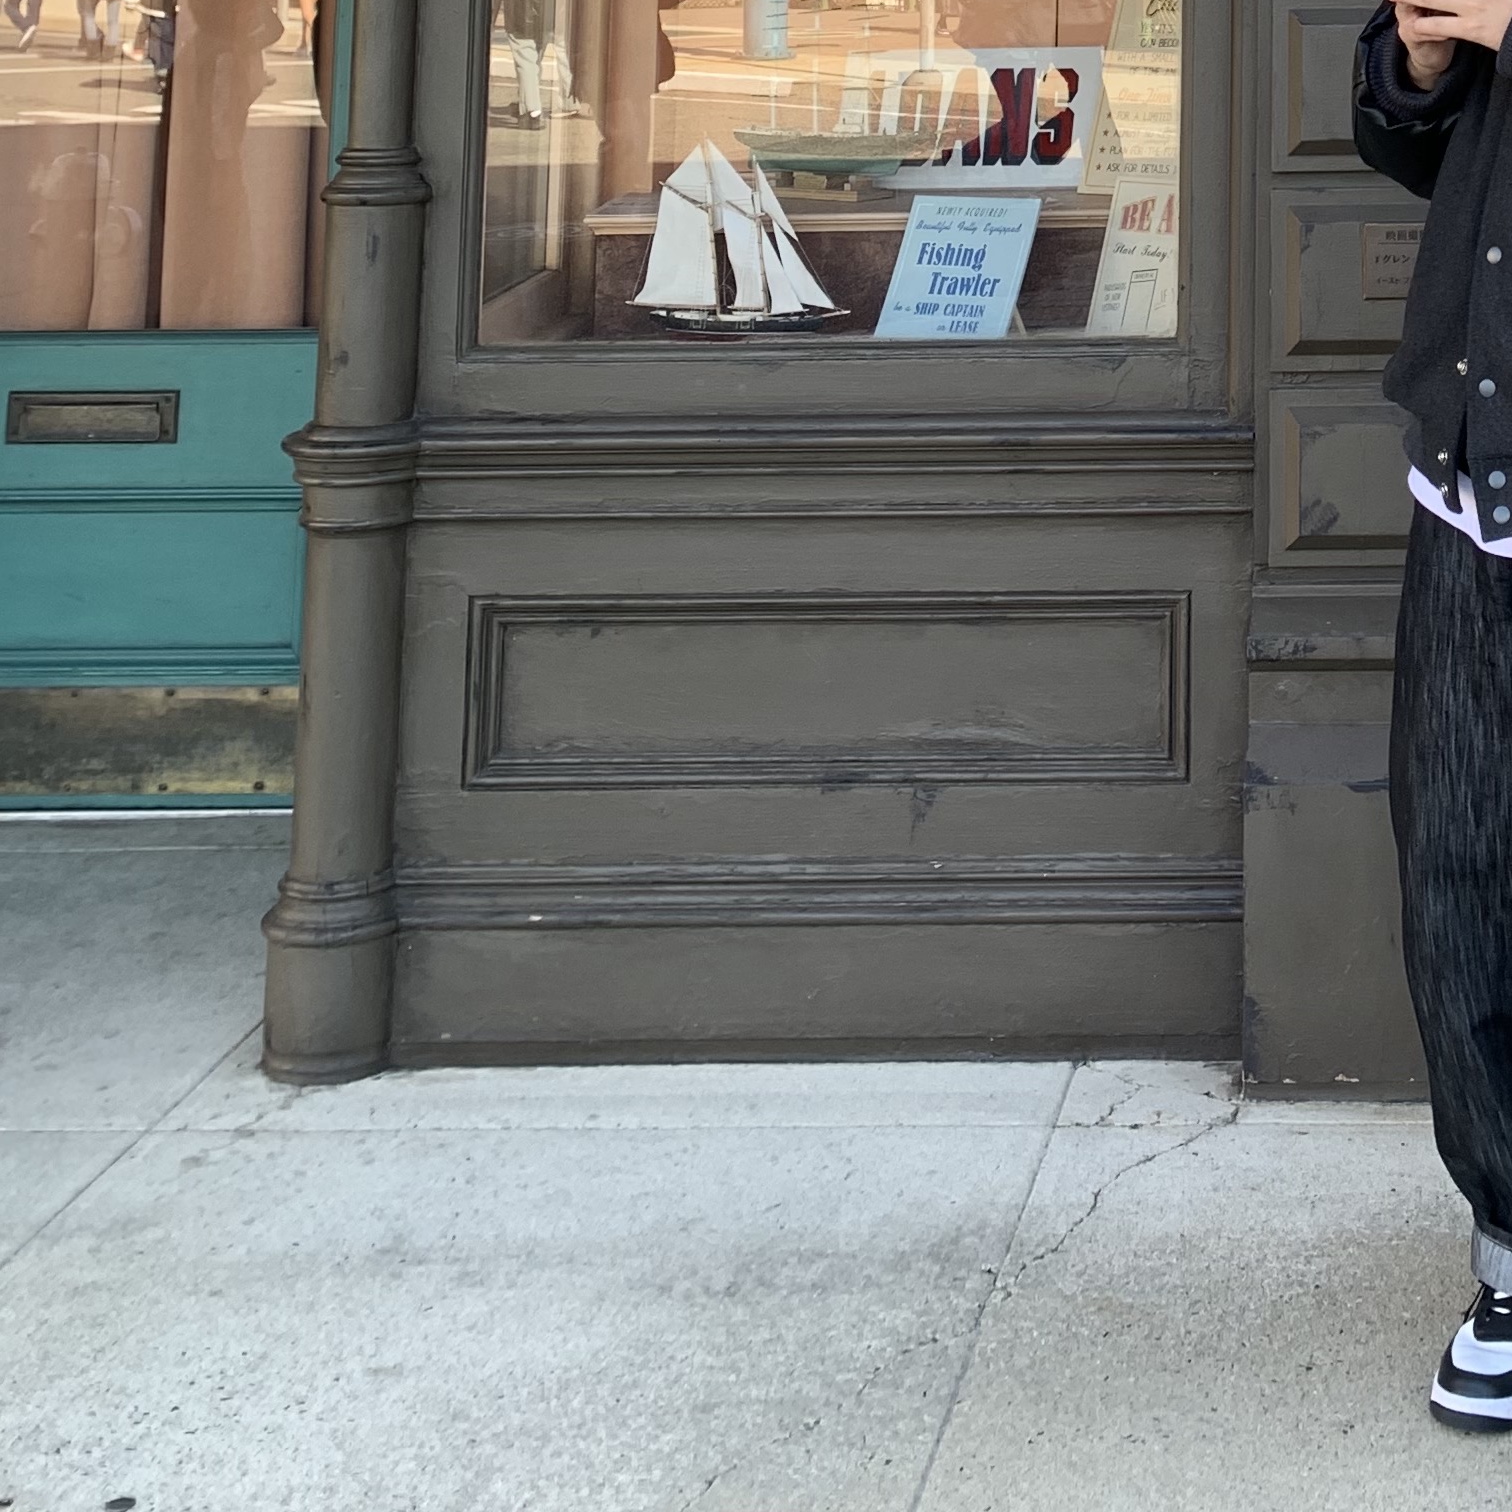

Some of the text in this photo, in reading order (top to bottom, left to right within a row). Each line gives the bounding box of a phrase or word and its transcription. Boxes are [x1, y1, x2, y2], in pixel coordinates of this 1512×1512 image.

[1106, 162, 1170, 174] ASK FOR DETAILS
[936, 206, 963, 216] NEWLY
[1119, 192, 1176, 235] BE A
[916, 242, 988, 272] Fishing
[928, 271, 1002, 298] Trawler
[914, 302, 940, 316] SHIP
[943, 303, 986, 319] CAPTAIN
[949, 320, 980, 334] LEASE
